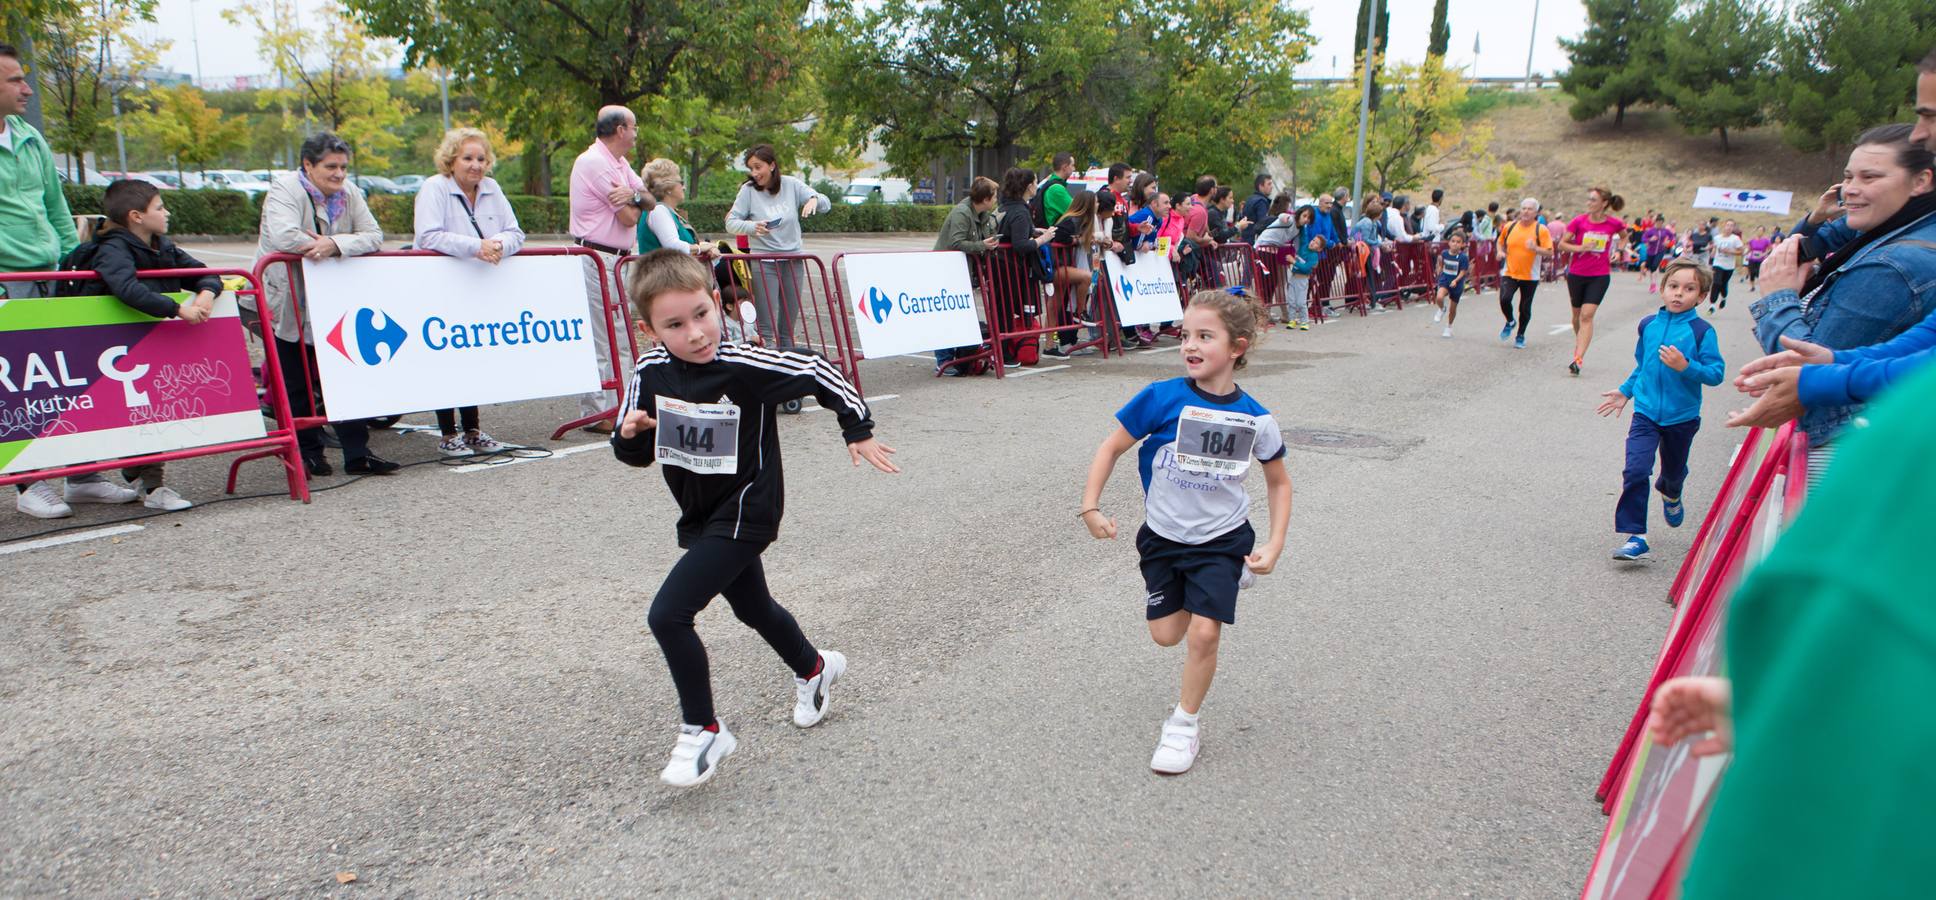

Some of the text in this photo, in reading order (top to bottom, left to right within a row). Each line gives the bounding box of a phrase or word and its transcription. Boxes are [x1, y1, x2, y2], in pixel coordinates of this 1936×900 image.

[1136, 277, 1175, 296] Carrefour
[898, 288, 970, 315] Carrefour
[422, 310, 584, 351] Carrefour
[24, 394, 94, 415] kutxa
[676, 423, 715, 453] 144
[1200, 429, 1236, 457] 184
[1166, 470, 1217, 492] Logroño
